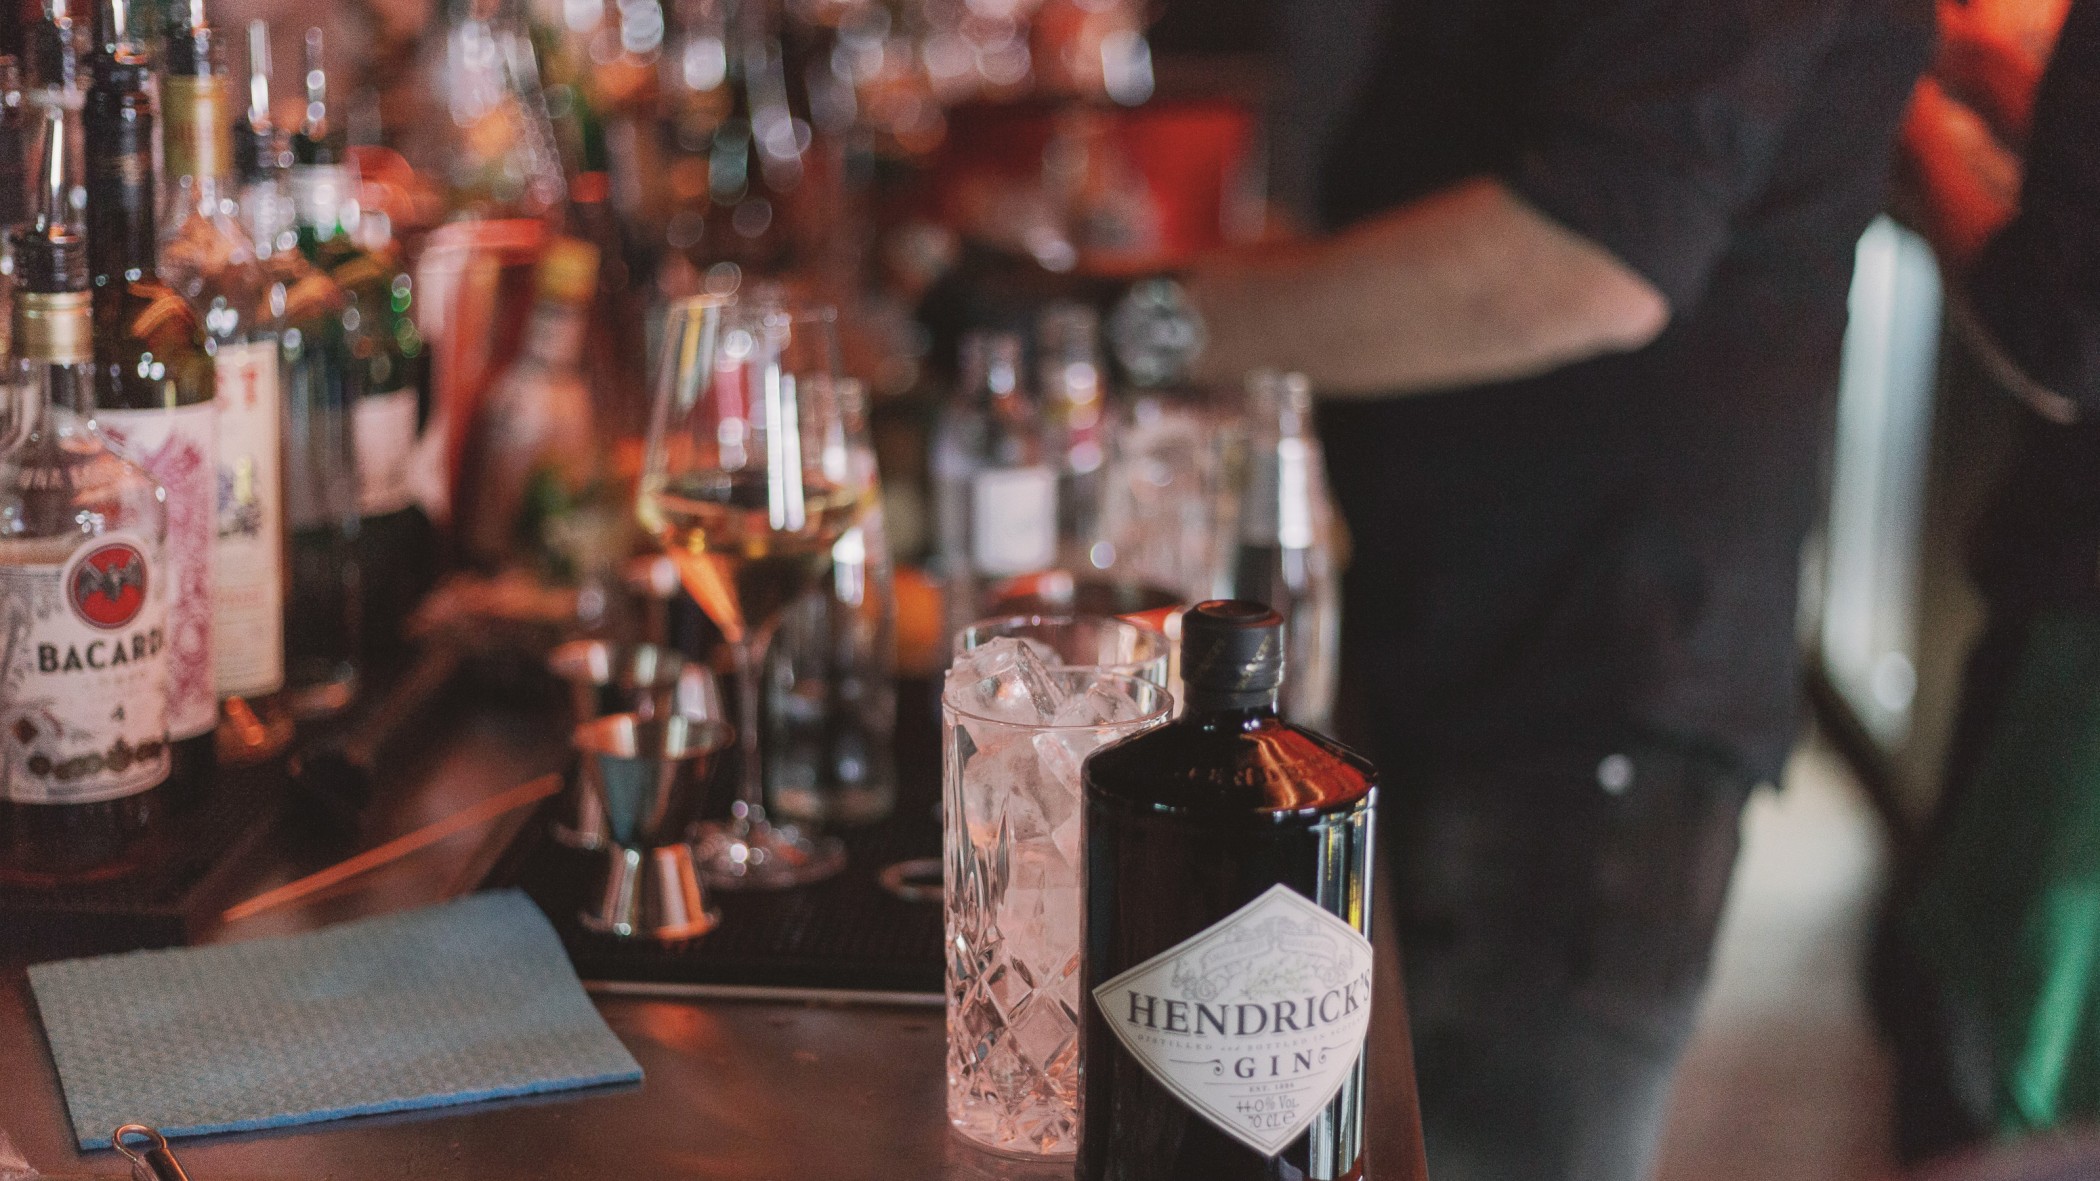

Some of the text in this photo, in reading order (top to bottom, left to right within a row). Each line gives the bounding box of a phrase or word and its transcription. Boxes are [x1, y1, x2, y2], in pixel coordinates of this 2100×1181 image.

[38, 626, 164, 673] BACARD
[1127, 968, 1370, 1036] HENDRICK'S
[1234, 1049, 1313, 1079] GIN
